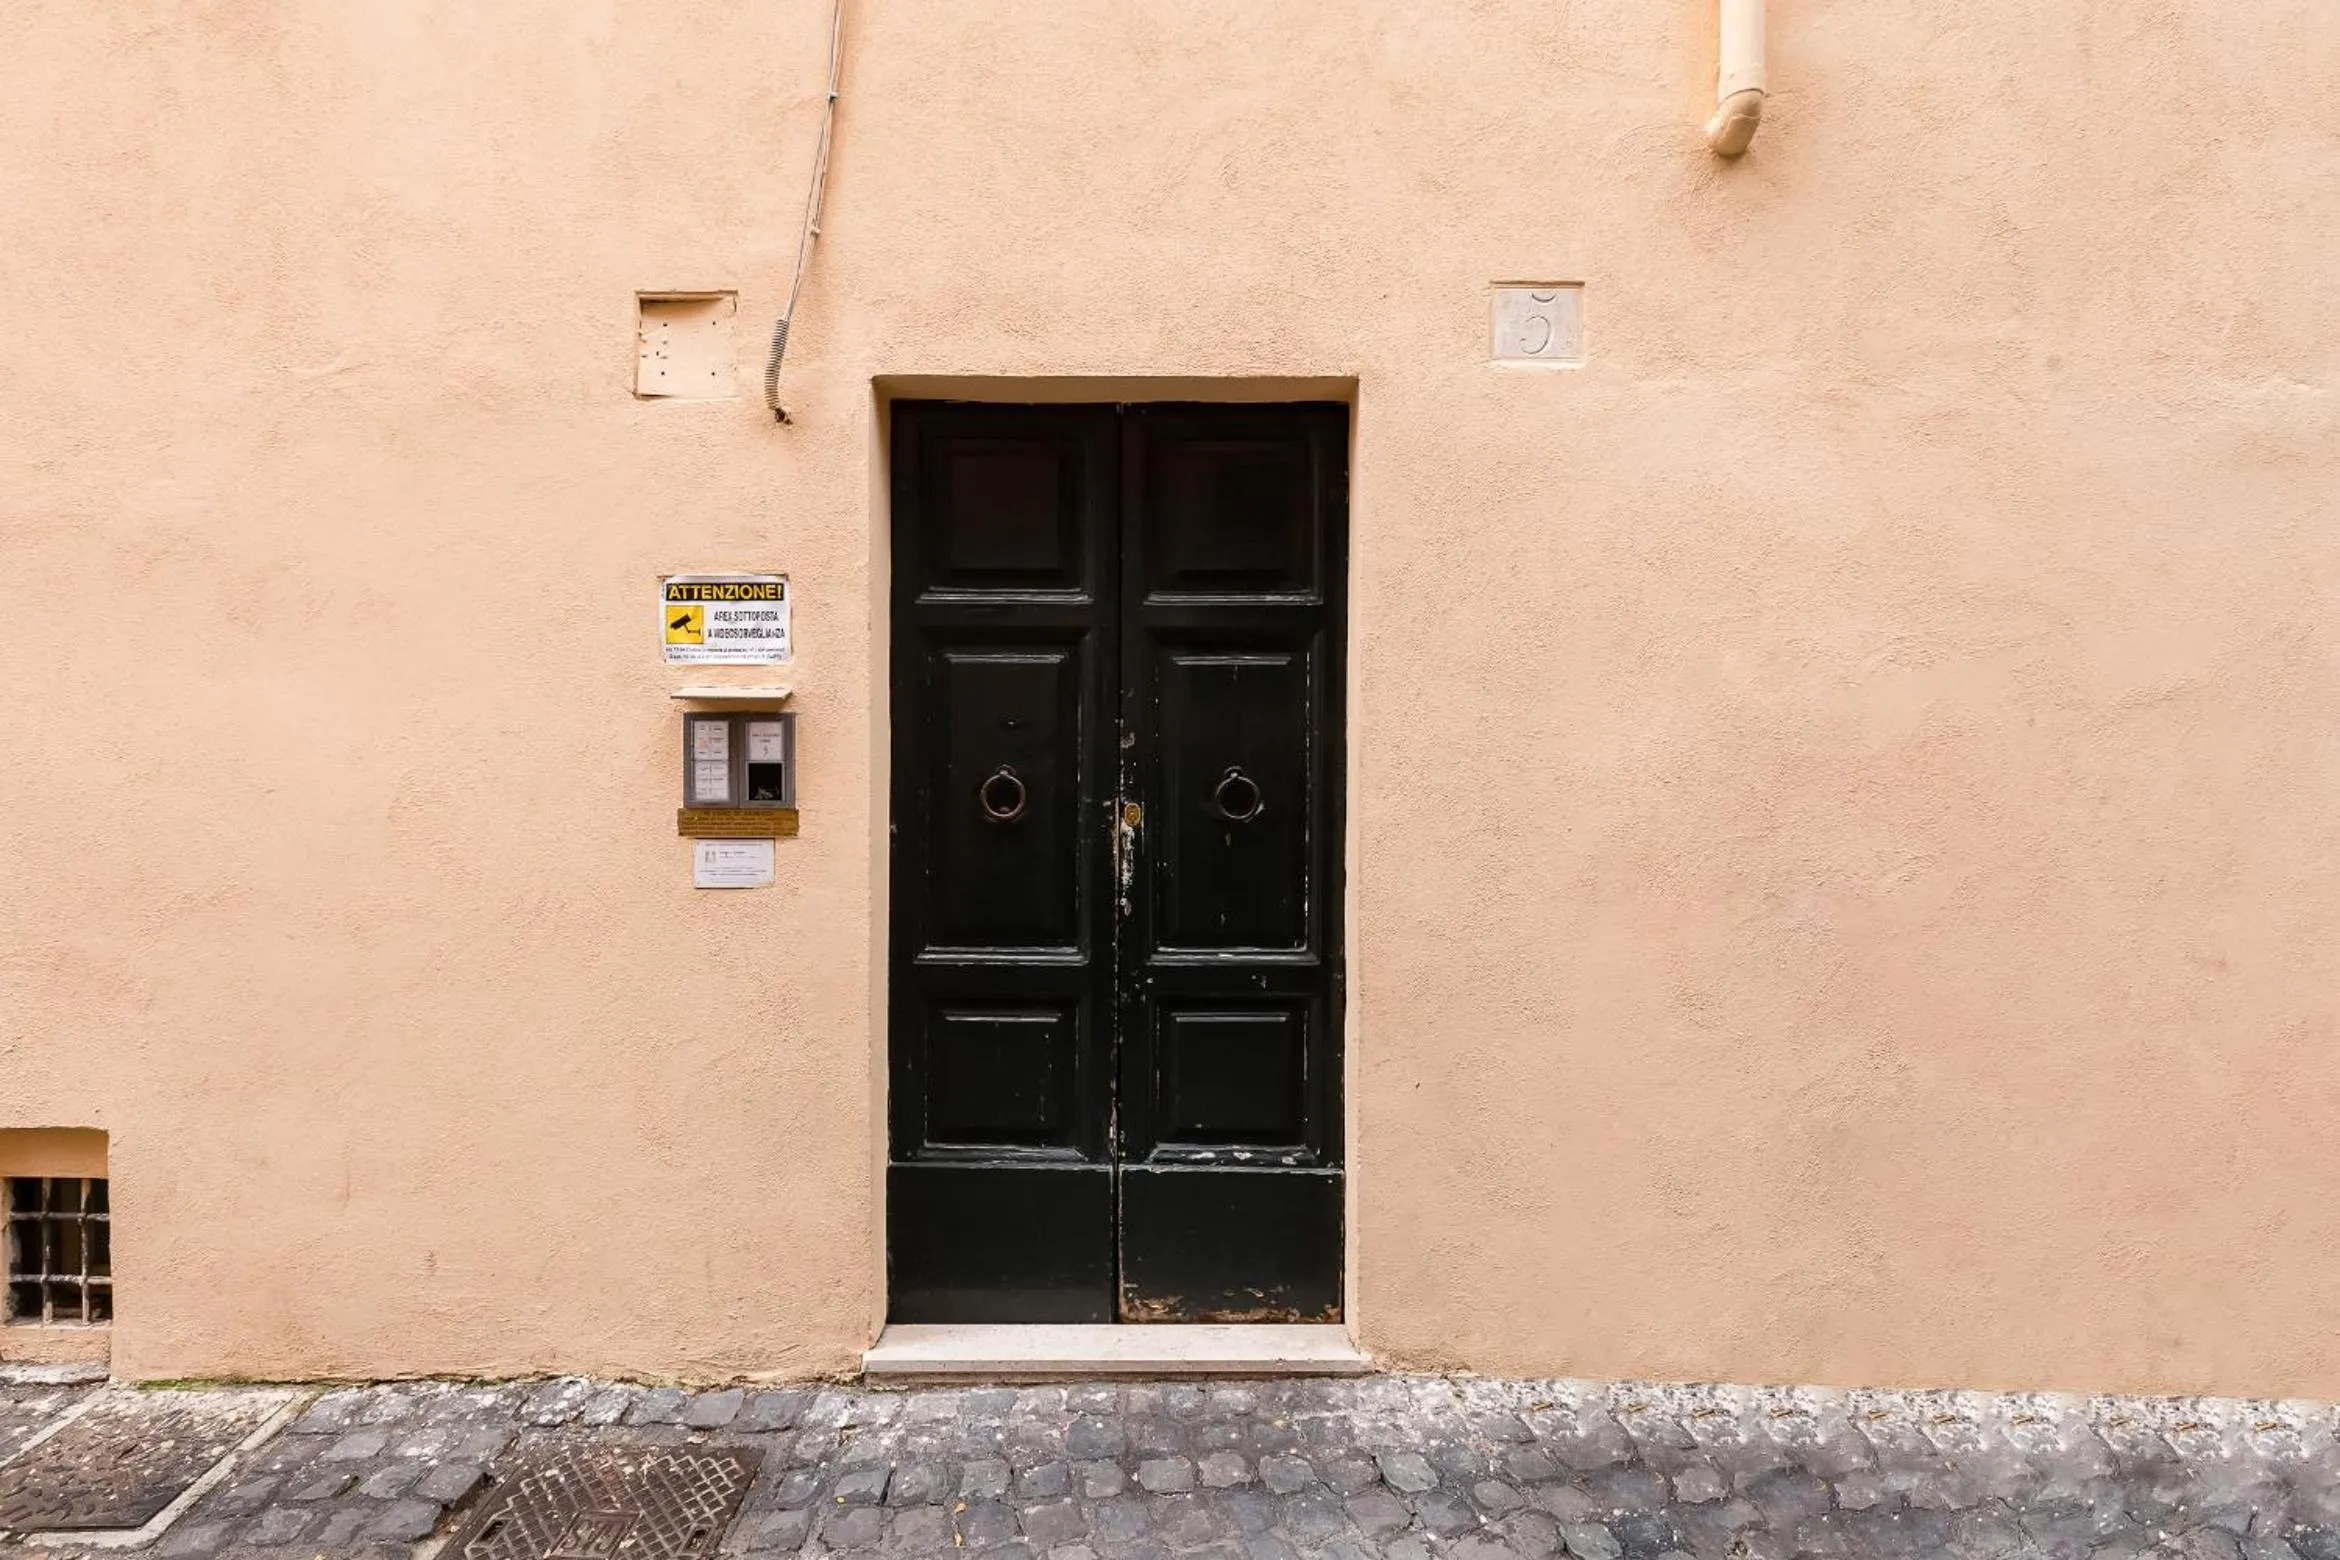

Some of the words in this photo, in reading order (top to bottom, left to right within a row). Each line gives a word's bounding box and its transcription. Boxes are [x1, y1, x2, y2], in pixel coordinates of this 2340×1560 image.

[1519, 292, 1557, 355] 5
[668, 585, 782, 600] ATTENZIONE!
[707, 628, 713, 639] A
